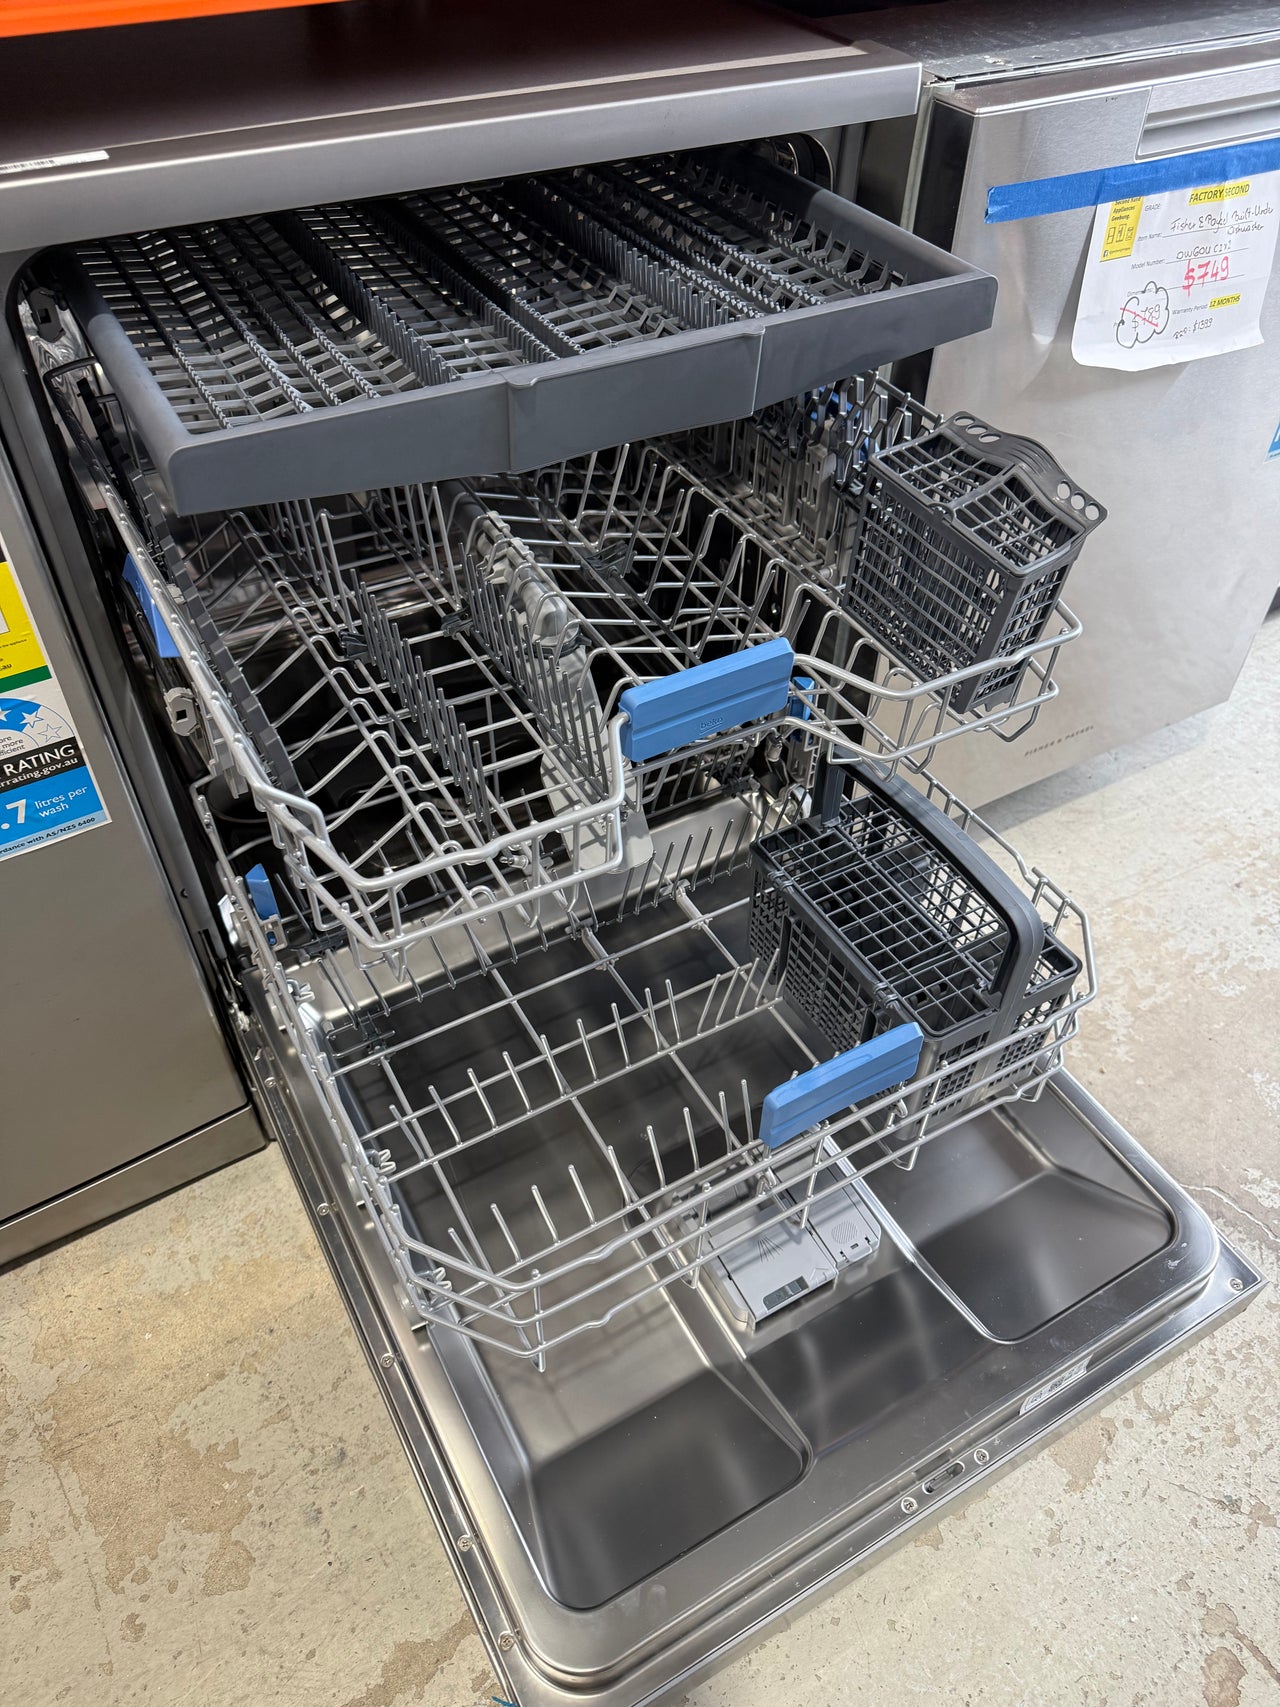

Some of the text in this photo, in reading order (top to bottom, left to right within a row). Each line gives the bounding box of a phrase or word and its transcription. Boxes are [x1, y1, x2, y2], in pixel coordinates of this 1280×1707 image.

[1188, 183, 1250, 203] FACTORY SECOND
[1113, 205, 1135, 214] Appliances
[1170, 217, 1197, 232] Fisher
[1181, 255, 1230, 297] $749
[1172, 306, 1194, 316] Warranty
[1209, 300, 1217, 309] 12
[1216, 294, 1241, 306] MONTHS
[700, 715, 724, 729] beko
[2, 739, 24, 749] more
[3, 744, 75, 777] RATING
[0, 757, 79, 788] rrating.gov.au
[34, 786, 88, 810] litres per
[39, 802, 70, 818] wash
[27, 833, 45, 845] with
[45, 823, 77, 839] AS/NZS
[77, 816, 96, 827] 6400
